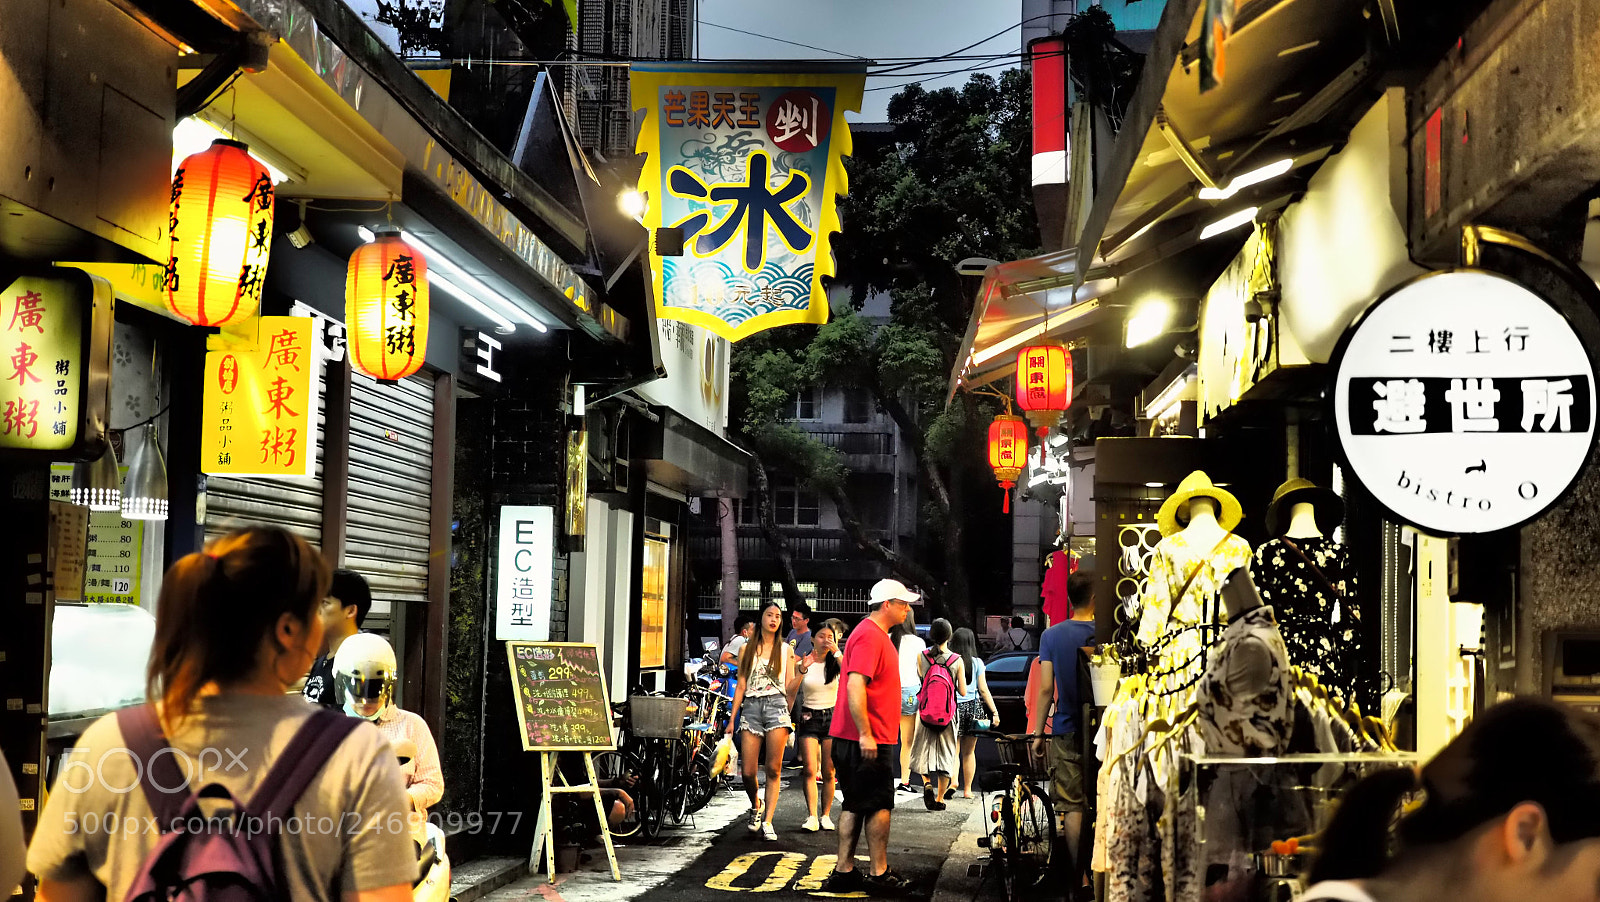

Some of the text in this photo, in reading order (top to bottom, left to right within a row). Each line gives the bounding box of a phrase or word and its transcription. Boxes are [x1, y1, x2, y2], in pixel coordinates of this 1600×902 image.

[663, 90, 760, 129] 芒果天王
[667, 152, 815, 272] 冰
[382, 254, 418, 357] 廣東粥
[1389, 327, 1530, 353] 二樓上行
[2, 291, 47, 439] 廣東粥
[260, 329, 302, 467] 廣東粥
[1372, 378, 1574, 433] 避世所
[1397, 470, 1491, 511] bistro
[120, 520, 133, 529] 80
[114, 581, 129, 592] 120
